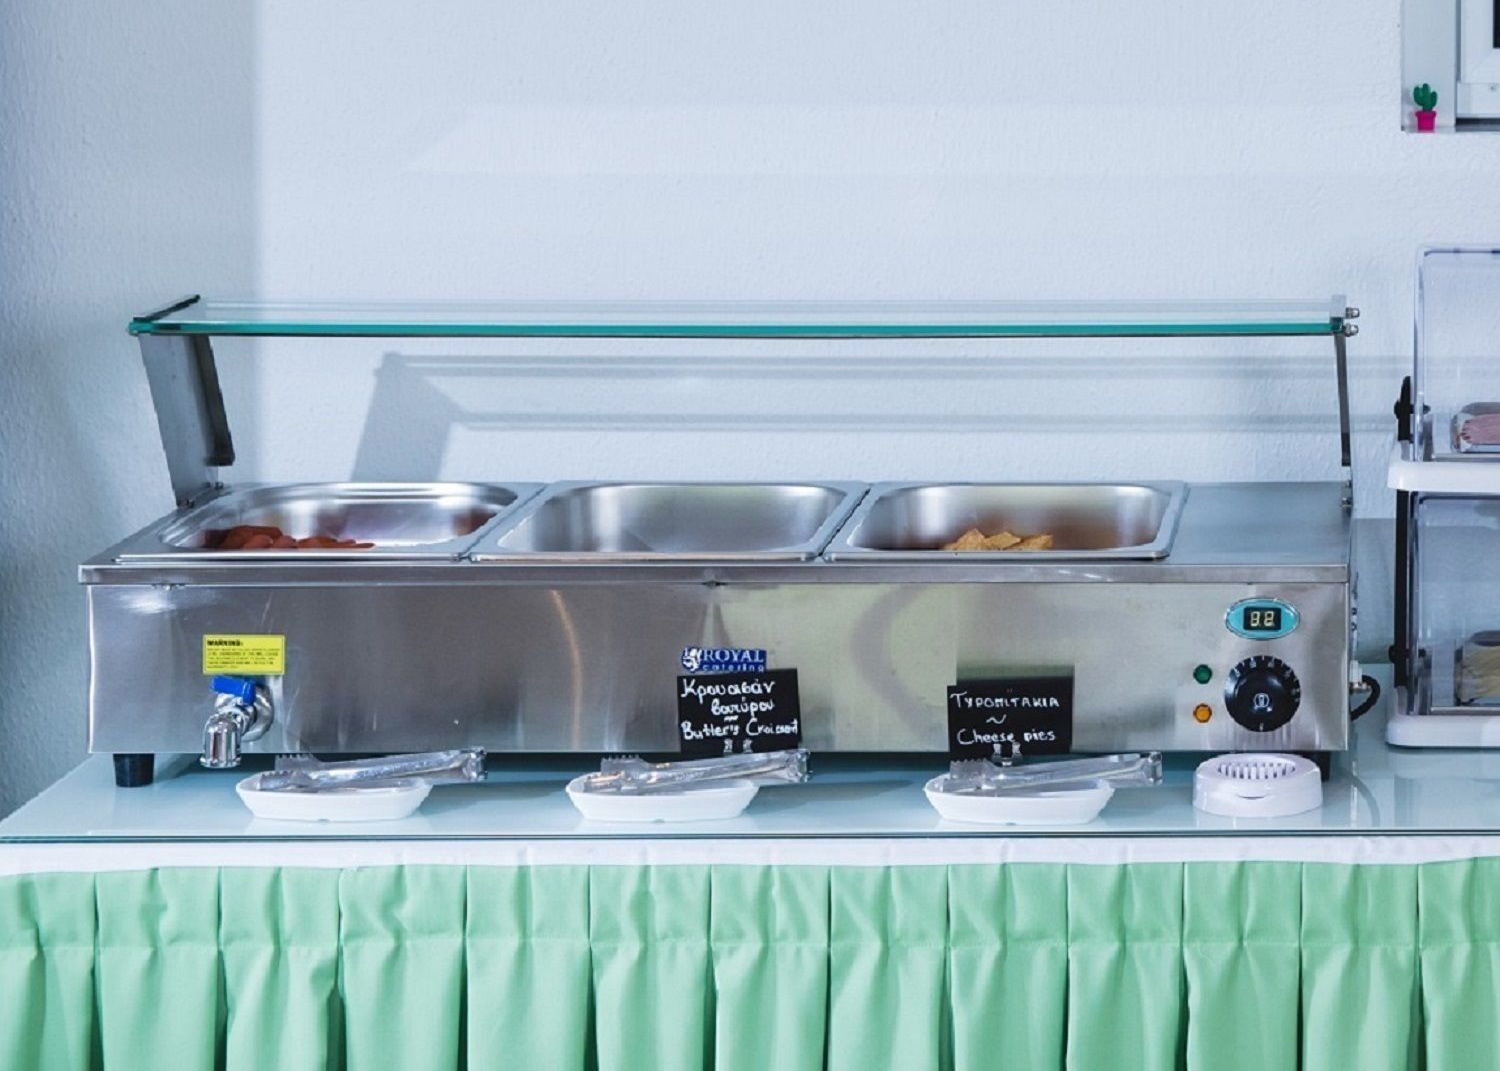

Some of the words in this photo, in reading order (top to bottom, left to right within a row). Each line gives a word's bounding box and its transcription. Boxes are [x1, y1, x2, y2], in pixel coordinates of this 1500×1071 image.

[703, 649, 764, 662] ROYAL
[957, 728, 1016, 745] Cheese
[1023, 728, 1056, 743] pies
